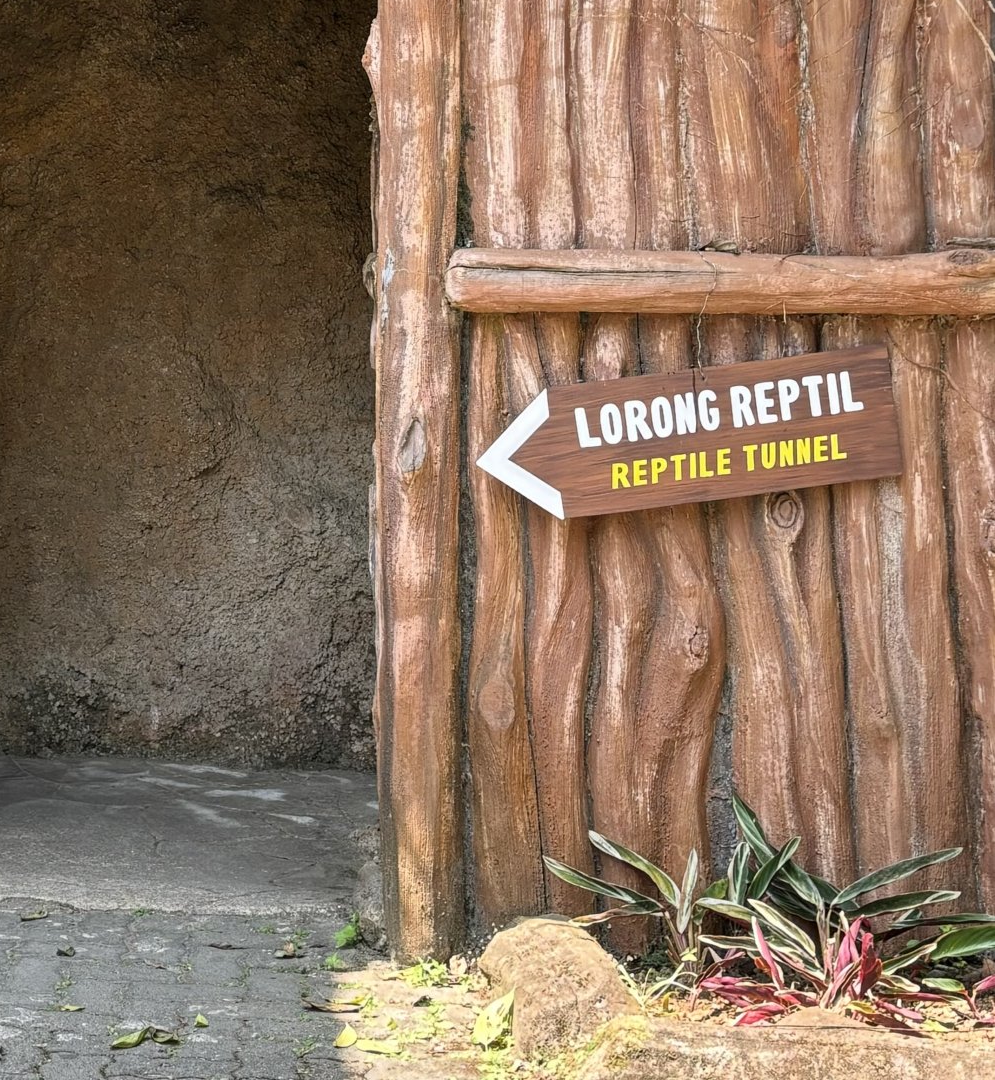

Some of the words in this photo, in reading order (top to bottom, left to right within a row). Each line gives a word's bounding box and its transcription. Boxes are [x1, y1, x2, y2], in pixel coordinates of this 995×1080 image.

[574, 390, 720, 448] LORONG
[731, 371, 864, 428] REPTIL
[611, 449, 731, 489] REPTILE
[743, 434, 847, 472] TUNNEL
